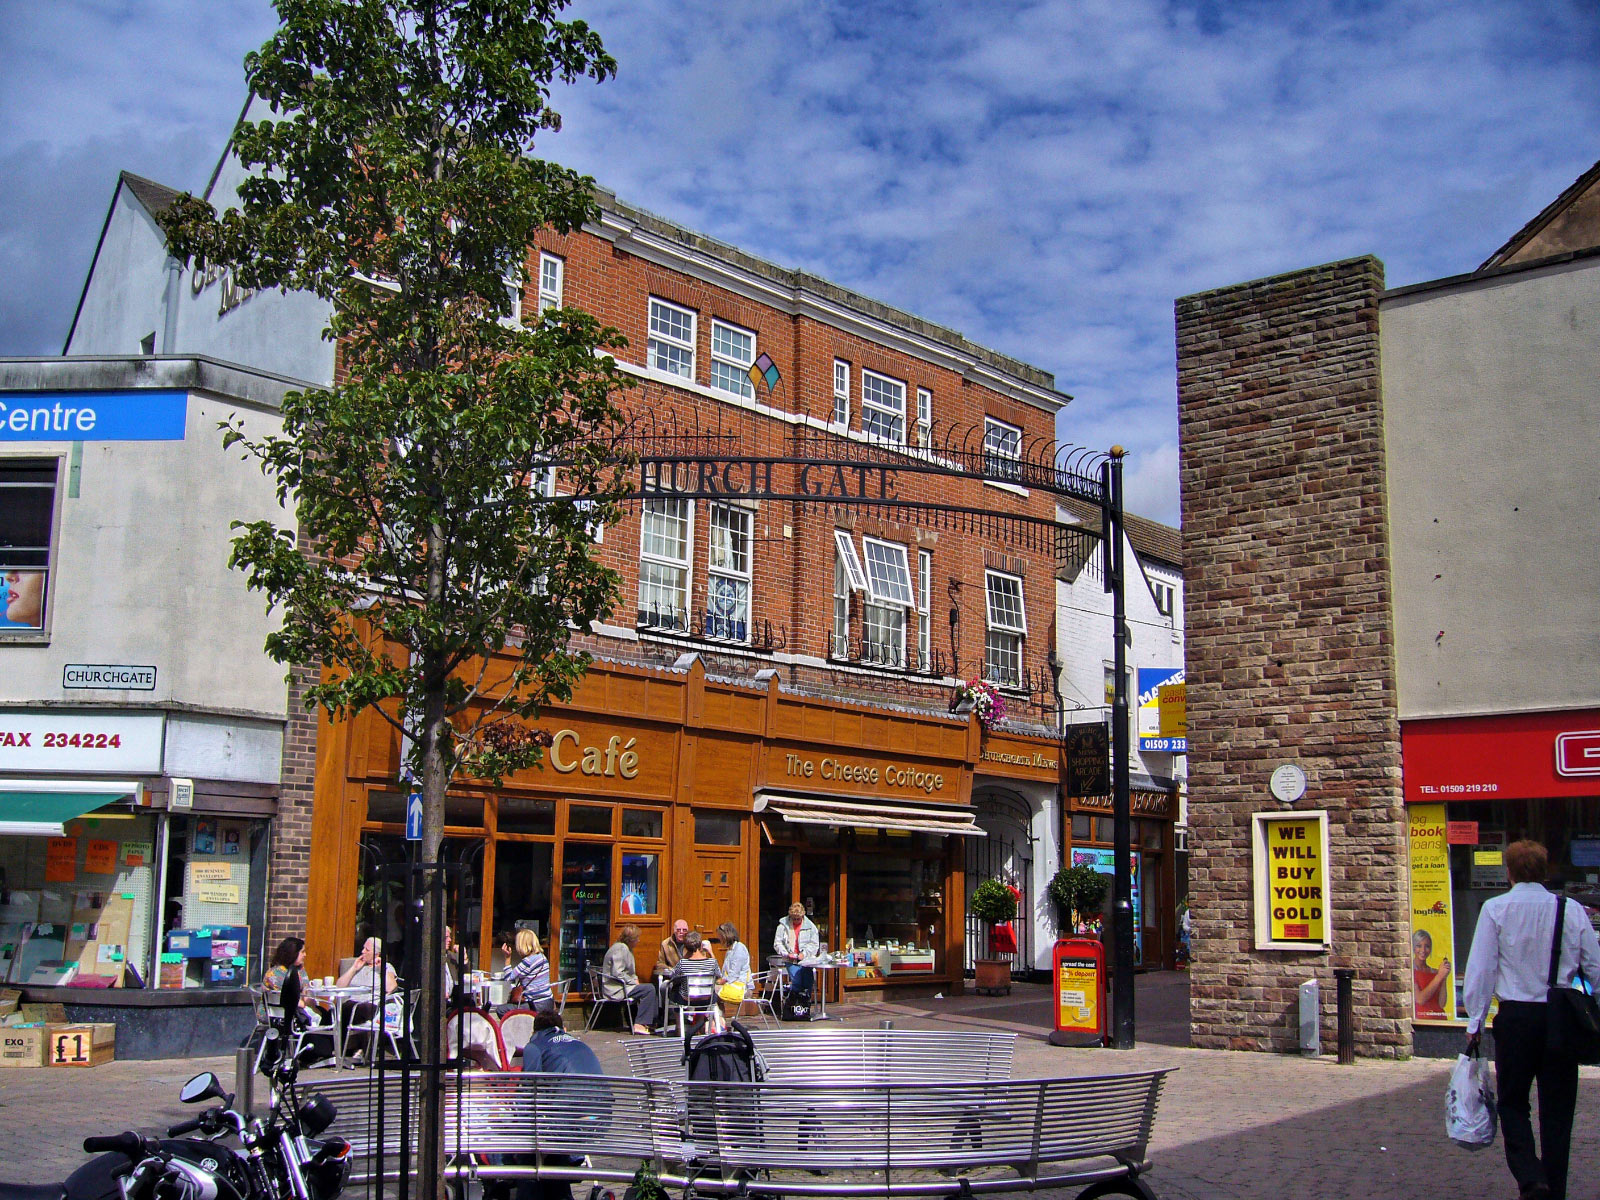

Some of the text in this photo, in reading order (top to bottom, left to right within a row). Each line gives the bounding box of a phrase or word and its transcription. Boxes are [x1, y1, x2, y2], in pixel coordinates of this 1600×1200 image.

[0, 401, 96, 431] entre
[614, 460, 899, 500] HURCH GATE
[67, 671, 152, 683] CHURCHGATE
[43, 732, 121, 748] 234224
[1145, 739, 1186, 750] 01509 233
[549, 729, 639, 779] Café
[1071, 757, 1105, 767] SHOPPING
[786, 753, 944, 793] The Cheese Cottage
[1074, 767, 1102, 776] ARCADE
[1420, 783, 1497, 794] TEL: 01509 219 210
[1409, 814, 1427, 827] log
[1278, 827, 1305, 840] WE
[1410, 826, 1444, 837] book
[1411, 839, 1442, 850] loans
[1272, 846, 1317, 860] WILL
[1411, 855, 1423, 863] got
[1412, 862, 1423, 870] get
[1277, 866, 1316, 880] BUY
[1273, 886, 1322, 900] YOUR
[1273, 907, 1322, 920] GOLD
[5, 1038, 24, 1046] EXQ
[55, 1034, 87, 1062] £1
